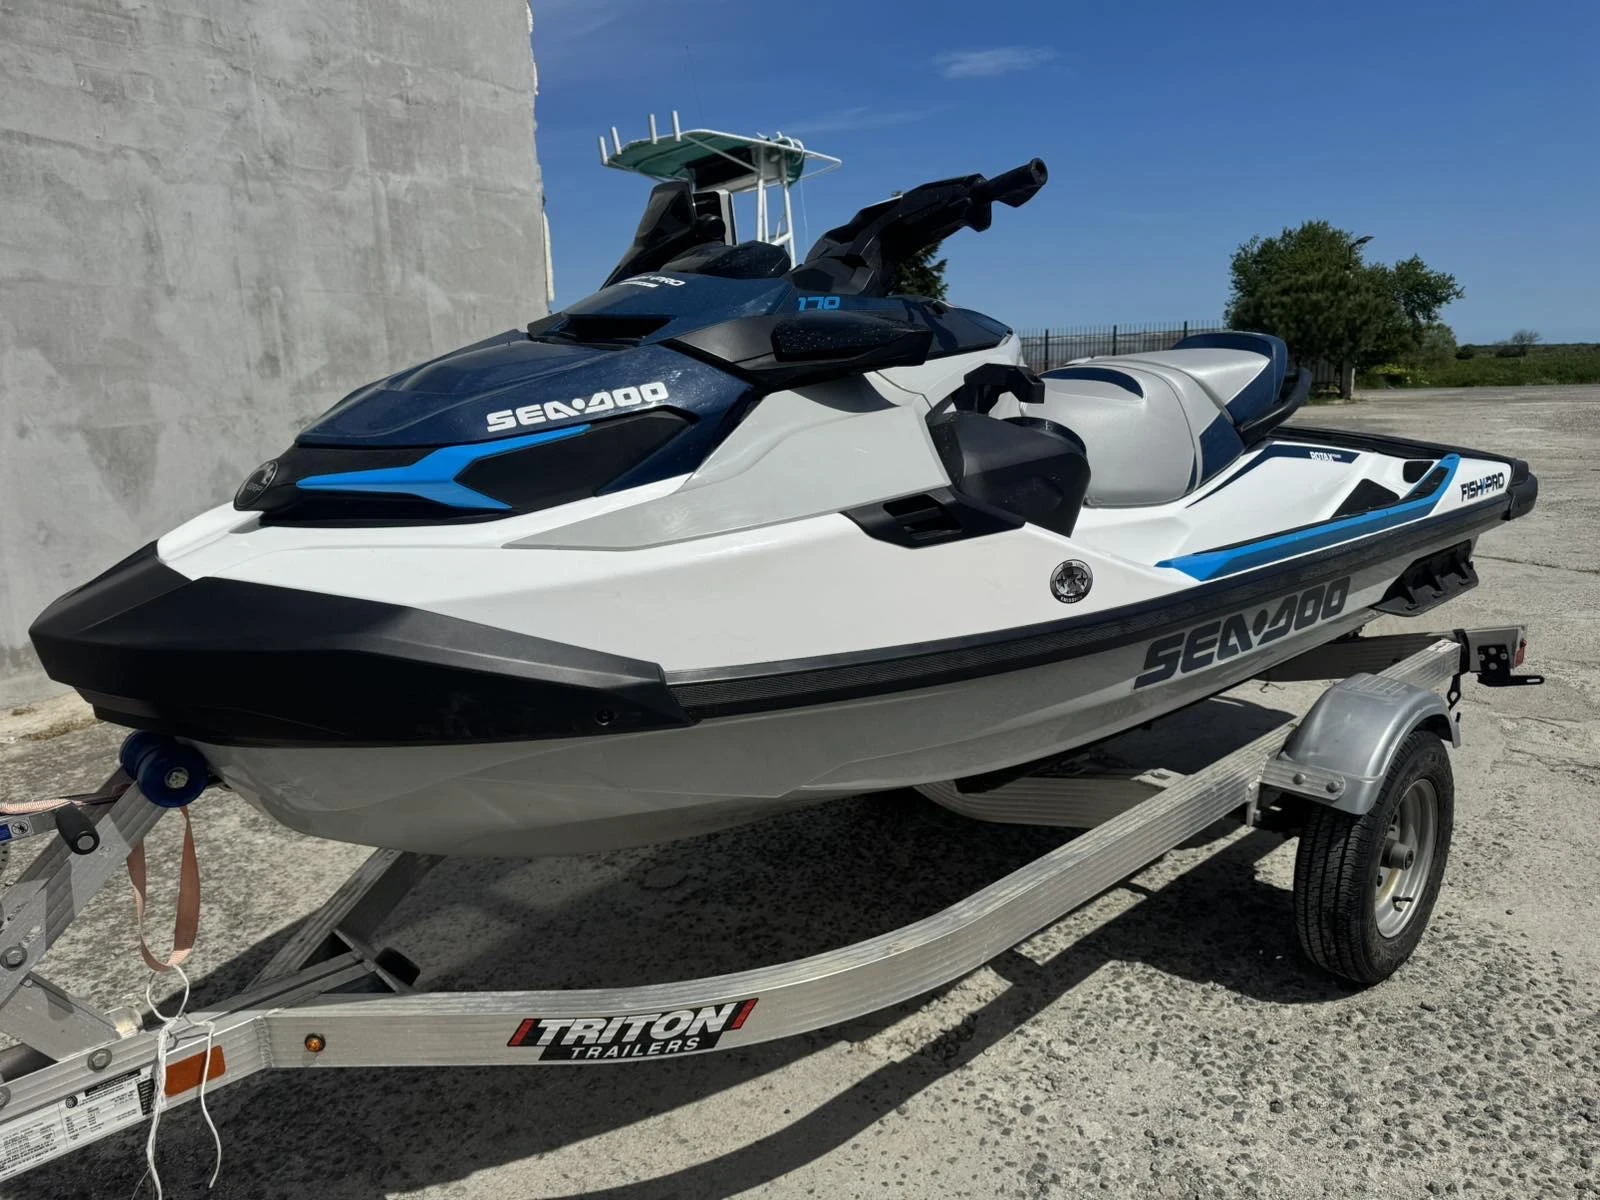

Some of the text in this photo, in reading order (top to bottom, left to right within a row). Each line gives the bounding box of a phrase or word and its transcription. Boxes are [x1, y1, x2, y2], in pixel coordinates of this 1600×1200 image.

[798, 296, 841, 311] 170
[536, 1003, 738, 1047] TRITON
[571, 1037, 701, 1060] TRAILERS
